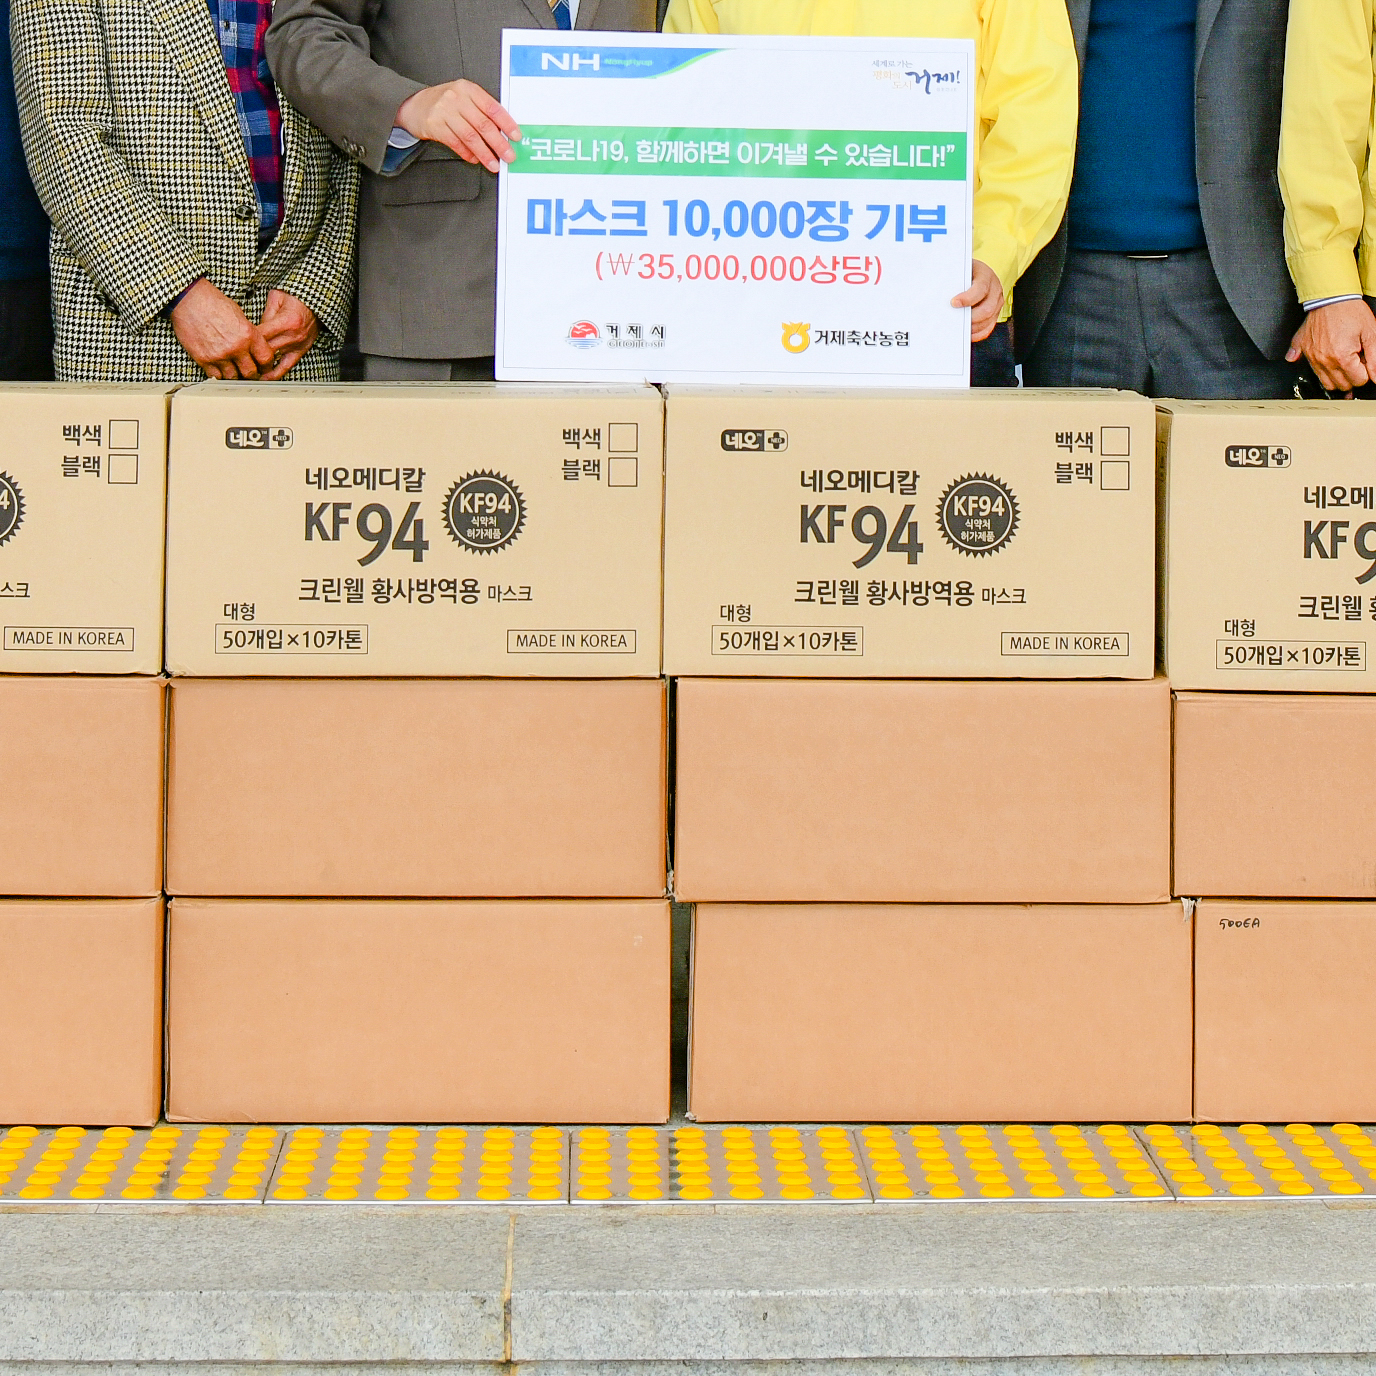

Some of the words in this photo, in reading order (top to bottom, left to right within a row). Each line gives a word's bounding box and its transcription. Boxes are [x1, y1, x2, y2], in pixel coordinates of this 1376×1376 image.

[541, 52, 600, 72] NH
[635, 141, 731, 166] 함께하면
[736, 142, 809, 167] 이겨낼
[814, 145, 838, 167] 수
[527, 199, 647, 236] 마스크
[663, 200, 853, 242] 10,000장
[865, 204, 947, 242] 기부
[606, 323, 667, 340] 거제시
[814, 329, 910, 348] 거제축산농협
[63, 425, 101, 446] 백색
[229, 430, 264, 447] 네오
[563, 428, 600, 449] 백색
[725, 432, 760, 450] 네오
[1056, 432, 1093, 453] 백색
[1229, 448, 1264, 465] 네오
[61, 456, 100, 477] 블랙
[562, 459, 600, 480] 블랙
[1054, 462, 1092, 484] 블랙
[306, 468, 426, 492] 네오메디칼
[801, 470, 920, 495] 네오메디칼
[459, 491, 512, 514] KF94
[953, 494, 1006, 517] KF94
[470, 515, 498, 529] 식약처
[964, 518, 992, 531] 식약처
[466, 527, 502, 541] 허가제품
[960, 530, 996, 543] 허가제품
[299, 578, 363, 603] 크린웰
[371, 578, 480, 604] 황사방역용
[488, 585, 532, 602] 마스크
[795, 580, 859, 605] 크린웰
[866, 580, 974, 606] 황사방역용
[982, 588, 1026, 605] 마스크
[224, 603, 254, 621] 대형
[720, 604, 750, 622] 대형
[1298, 596, 1361, 620] 크린웰
[1225, 619, 1255, 637] 대형
[13, 632, 53, 644] MADE
[59, 632, 72, 644] IN
[78, 632, 124, 645] KOREA
[517, 635, 556, 647] MADE
[562, 635, 574, 647] IN
[581, 635, 627, 647] KOREA
[1011, 637, 1050, 649] MADE
[1056, 637, 1068, 649] IN
[1074, 637, 1120, 649] KOREA
[1219, 917, 1261, 930] 500EA
